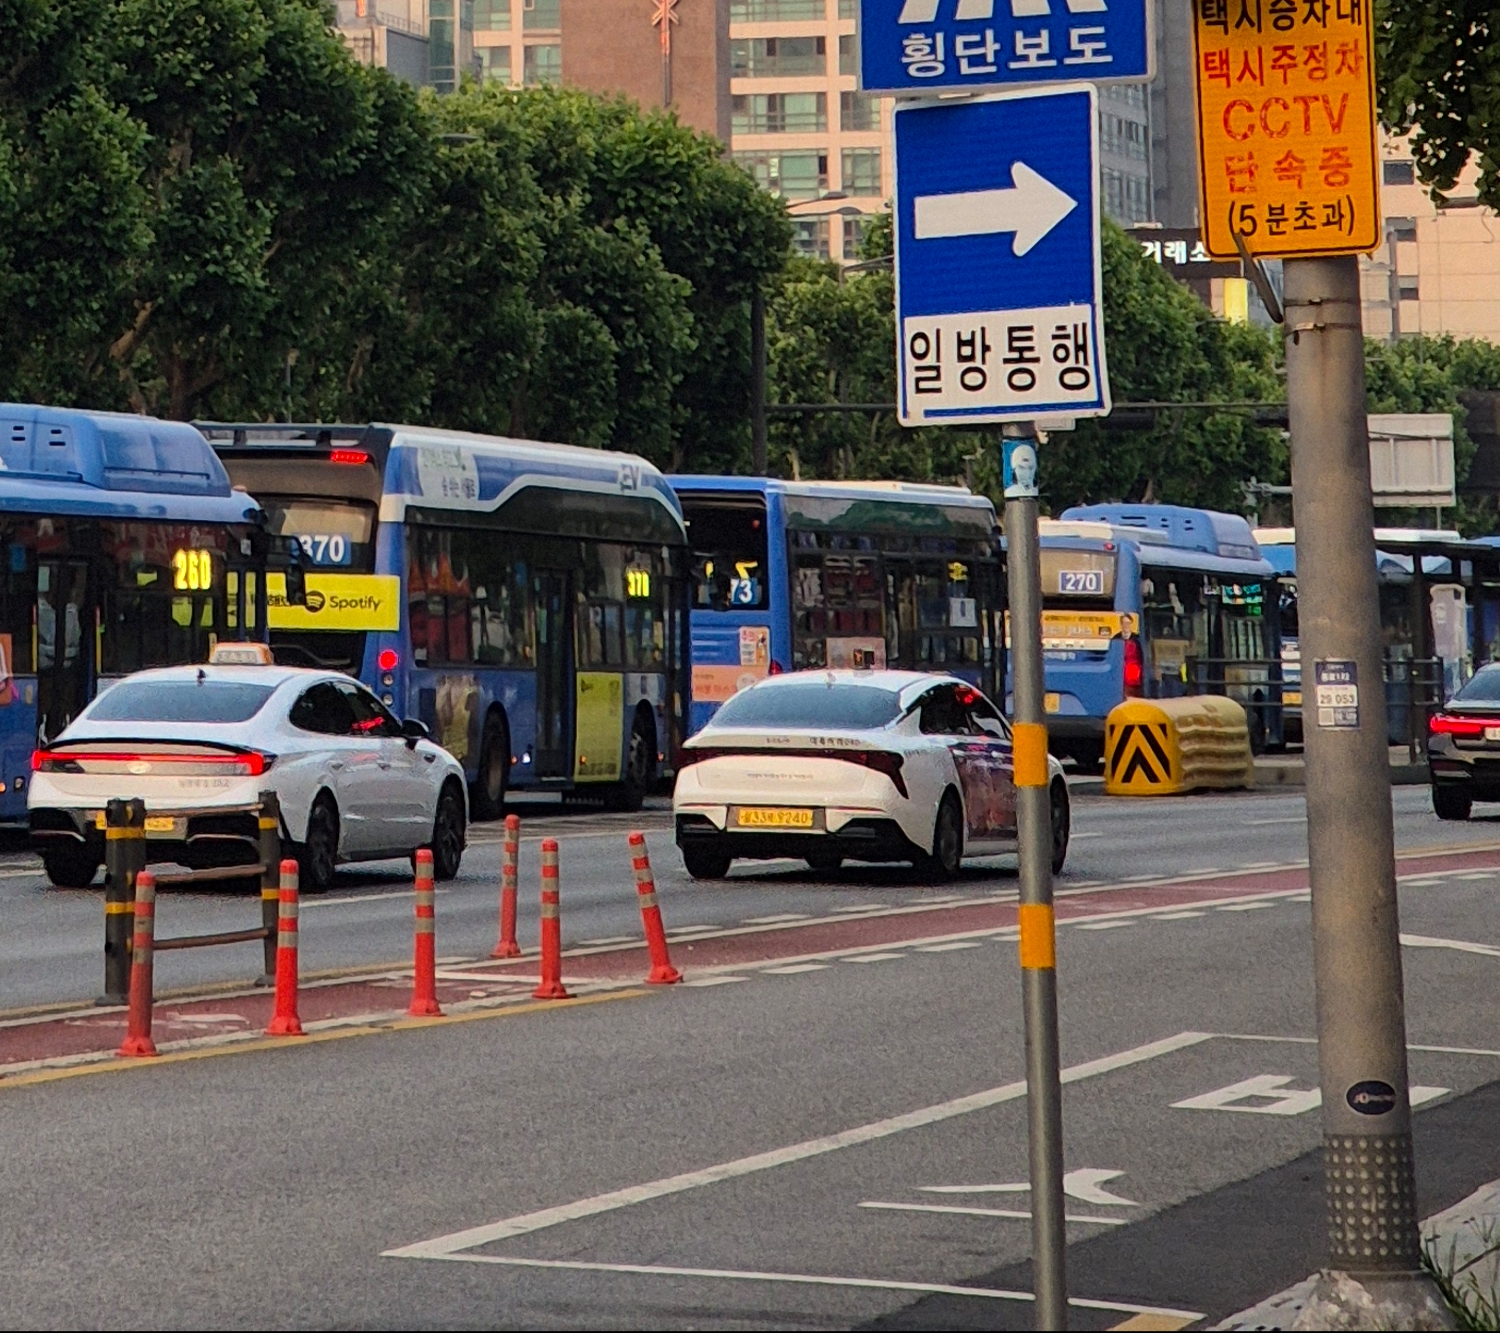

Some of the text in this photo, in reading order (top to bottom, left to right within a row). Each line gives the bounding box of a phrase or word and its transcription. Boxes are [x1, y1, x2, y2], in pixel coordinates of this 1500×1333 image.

[900, 25, 1114, 78] 횡단보도
[1203, 37, 1365, 89] 택시주정차
[1222, 92, 1350, 142] CCTV
[1225, 145, 1355, 195] 단속중
[1140, 240, 1213, 266] 거래소
[909, 321, 1091, 395] 일방통행
[174, 548, 213, 591] 260
[300, 534, 346, 563] 370
[329, 595, 384, 612] Spotify
[1065, 573, 1098, 592] 270
